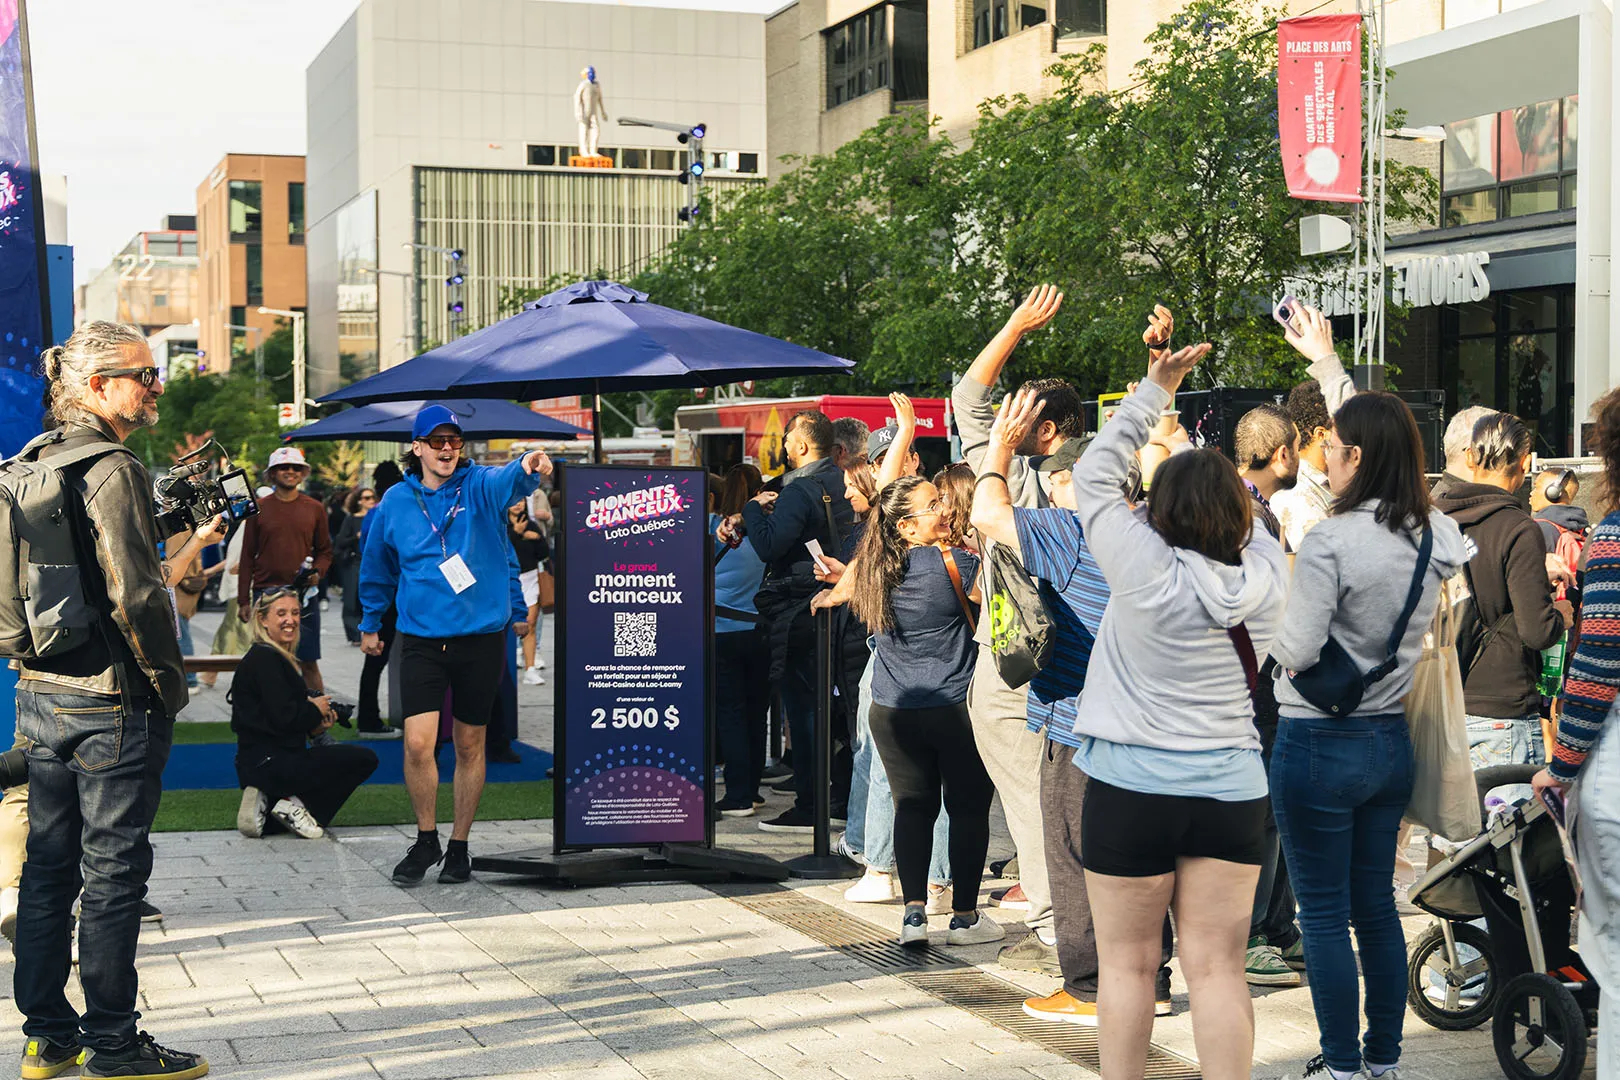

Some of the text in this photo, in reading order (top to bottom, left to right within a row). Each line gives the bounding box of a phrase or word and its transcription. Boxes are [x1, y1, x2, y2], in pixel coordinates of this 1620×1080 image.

[1286, 40, 1352, 52] PLACE DES ARTS
[1315, 61, 1325, 143] DES SPECTACLES
[1305, 95, 1316, 143] QUARTIER
[1391, 251, 1490, 308] FAVORIS
[590, 484, 675, 514] MOMENTS
[585, 495, 682, 528] CHANCEUX
[604, 518, 676, 540] Loto Québec
[595, 572, 676, 588] moment
[613, 563, 657, 573] Le grand
[588, 588, 683, 604] chanceux
[646, 681, 682, 689] Lac-Leamy
[591, 705, 680, 731] 2 500 $
